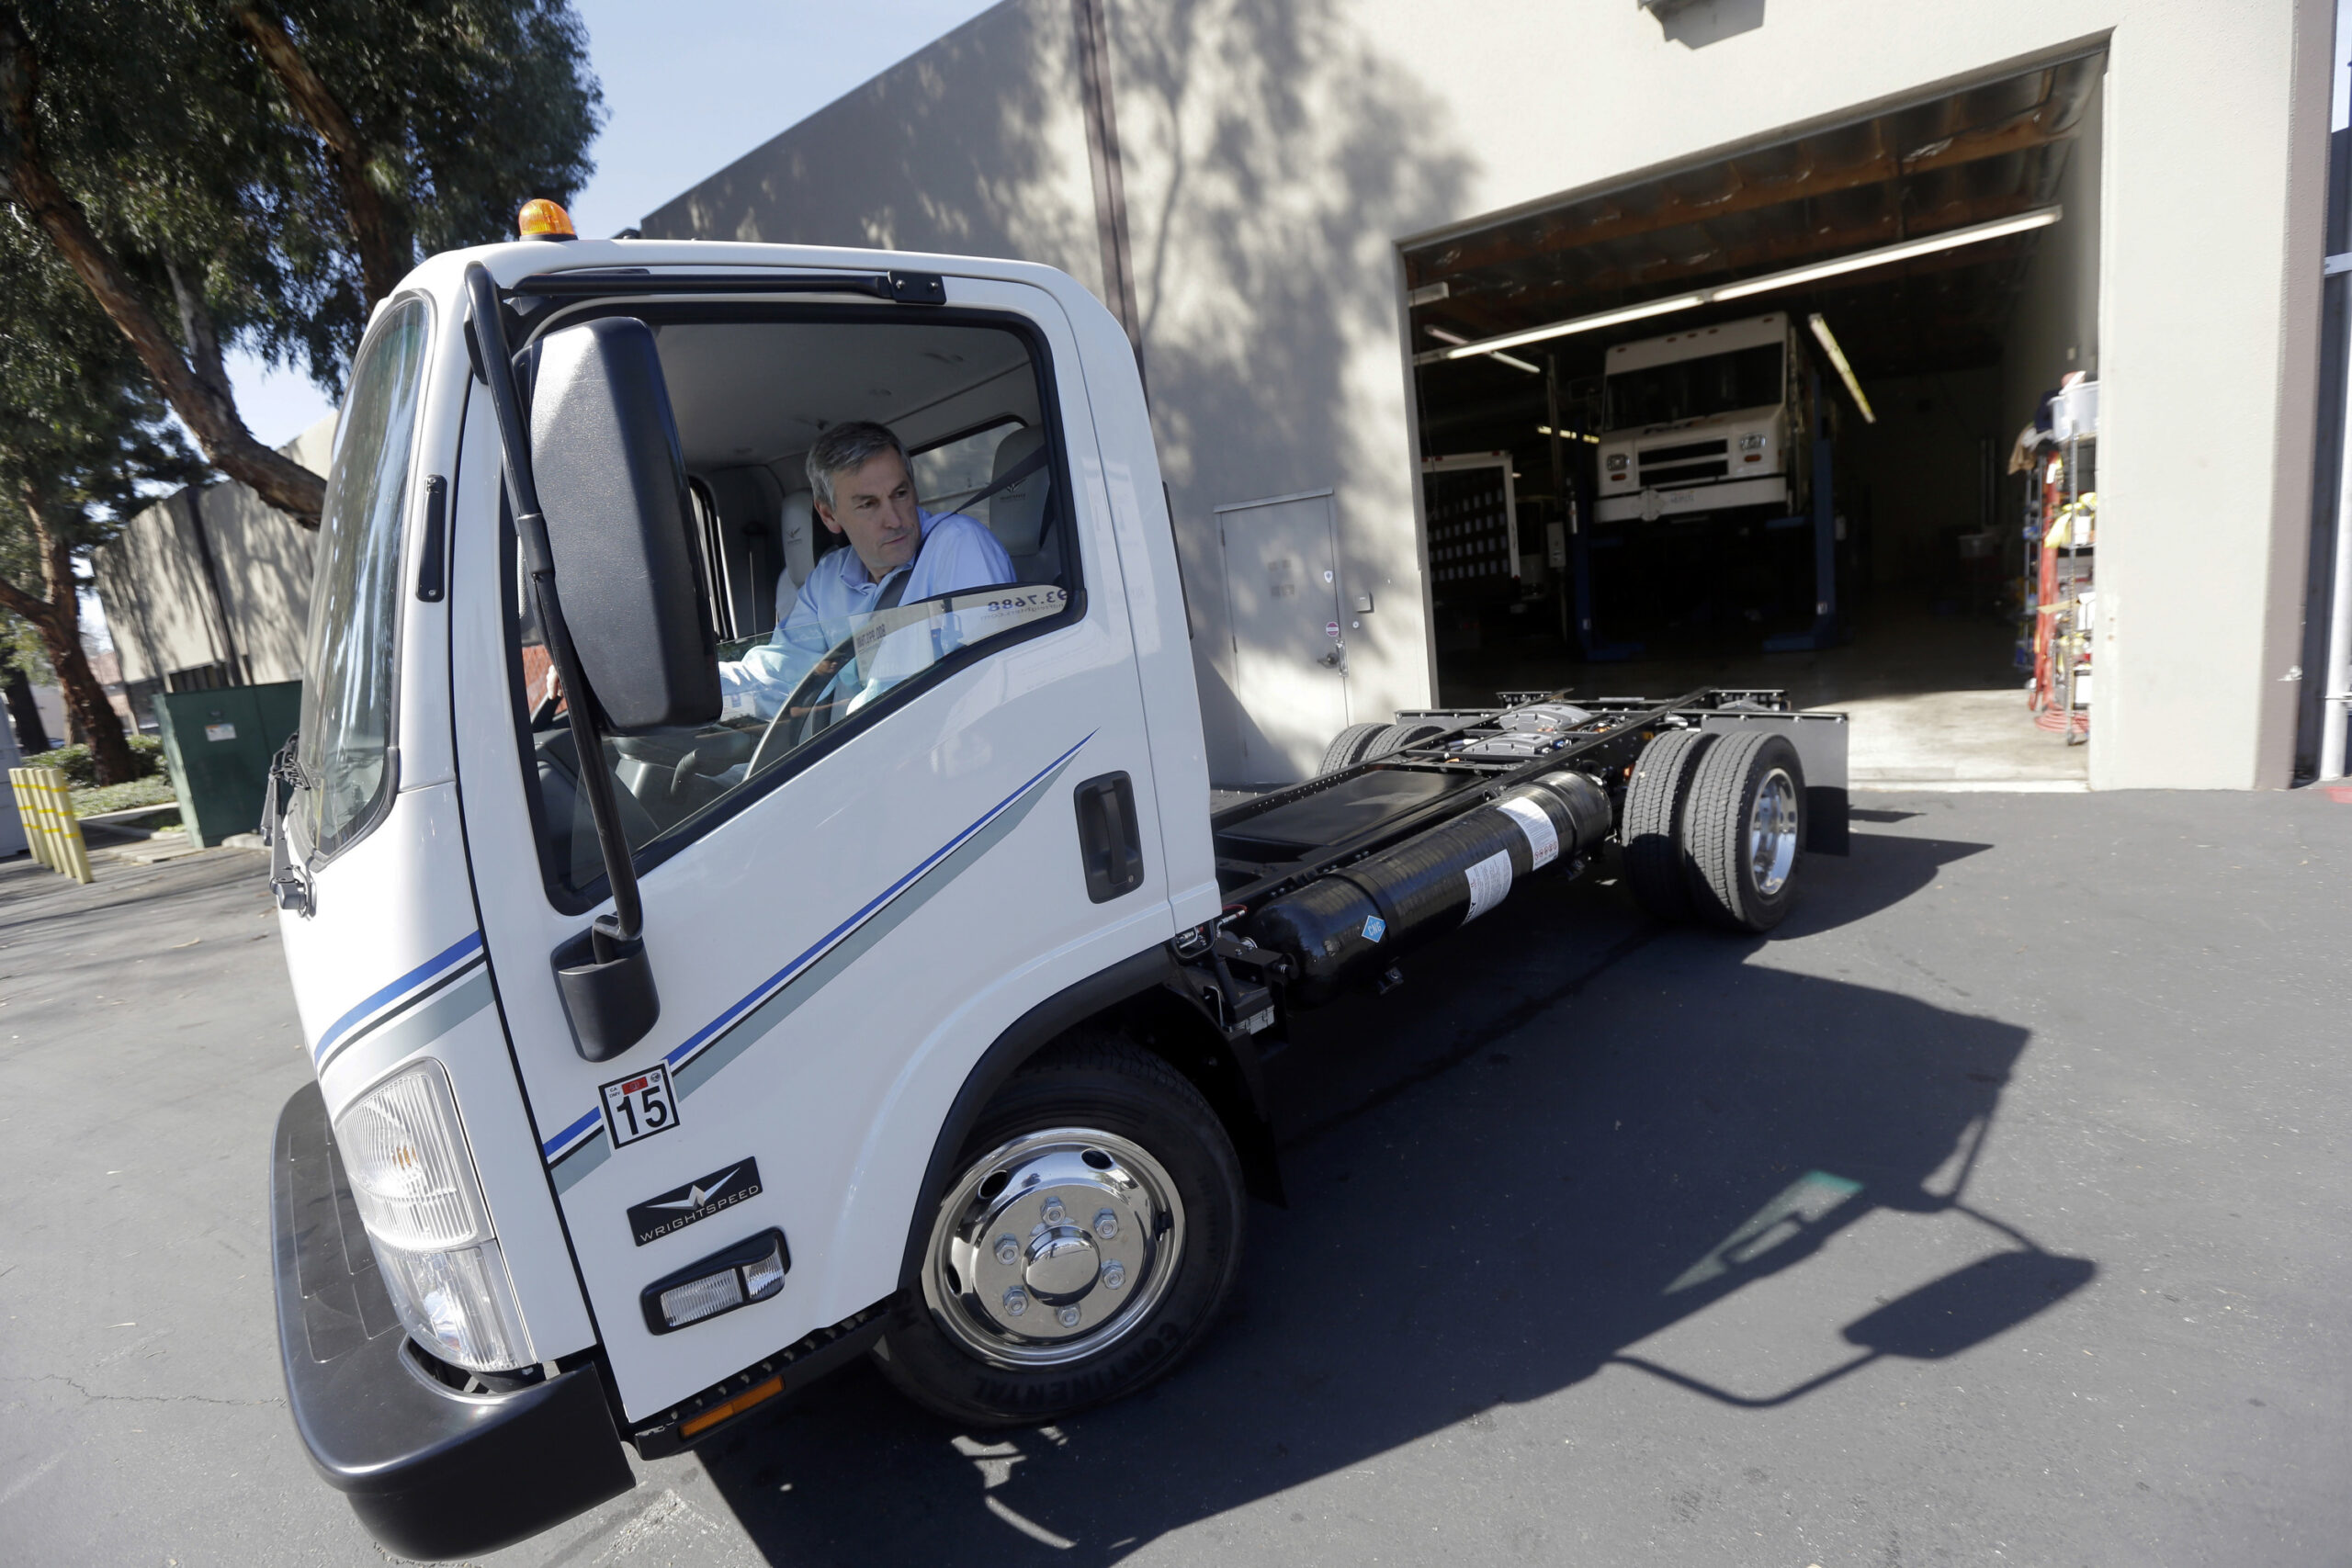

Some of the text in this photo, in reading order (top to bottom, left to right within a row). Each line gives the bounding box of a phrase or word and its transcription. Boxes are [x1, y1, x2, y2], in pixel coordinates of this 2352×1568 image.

[1367, 918, 1382, 936] CNG
[616, 1086, 667, 1135] 15
[640, 1185, 759, 1242] WRIGHTSPEED
